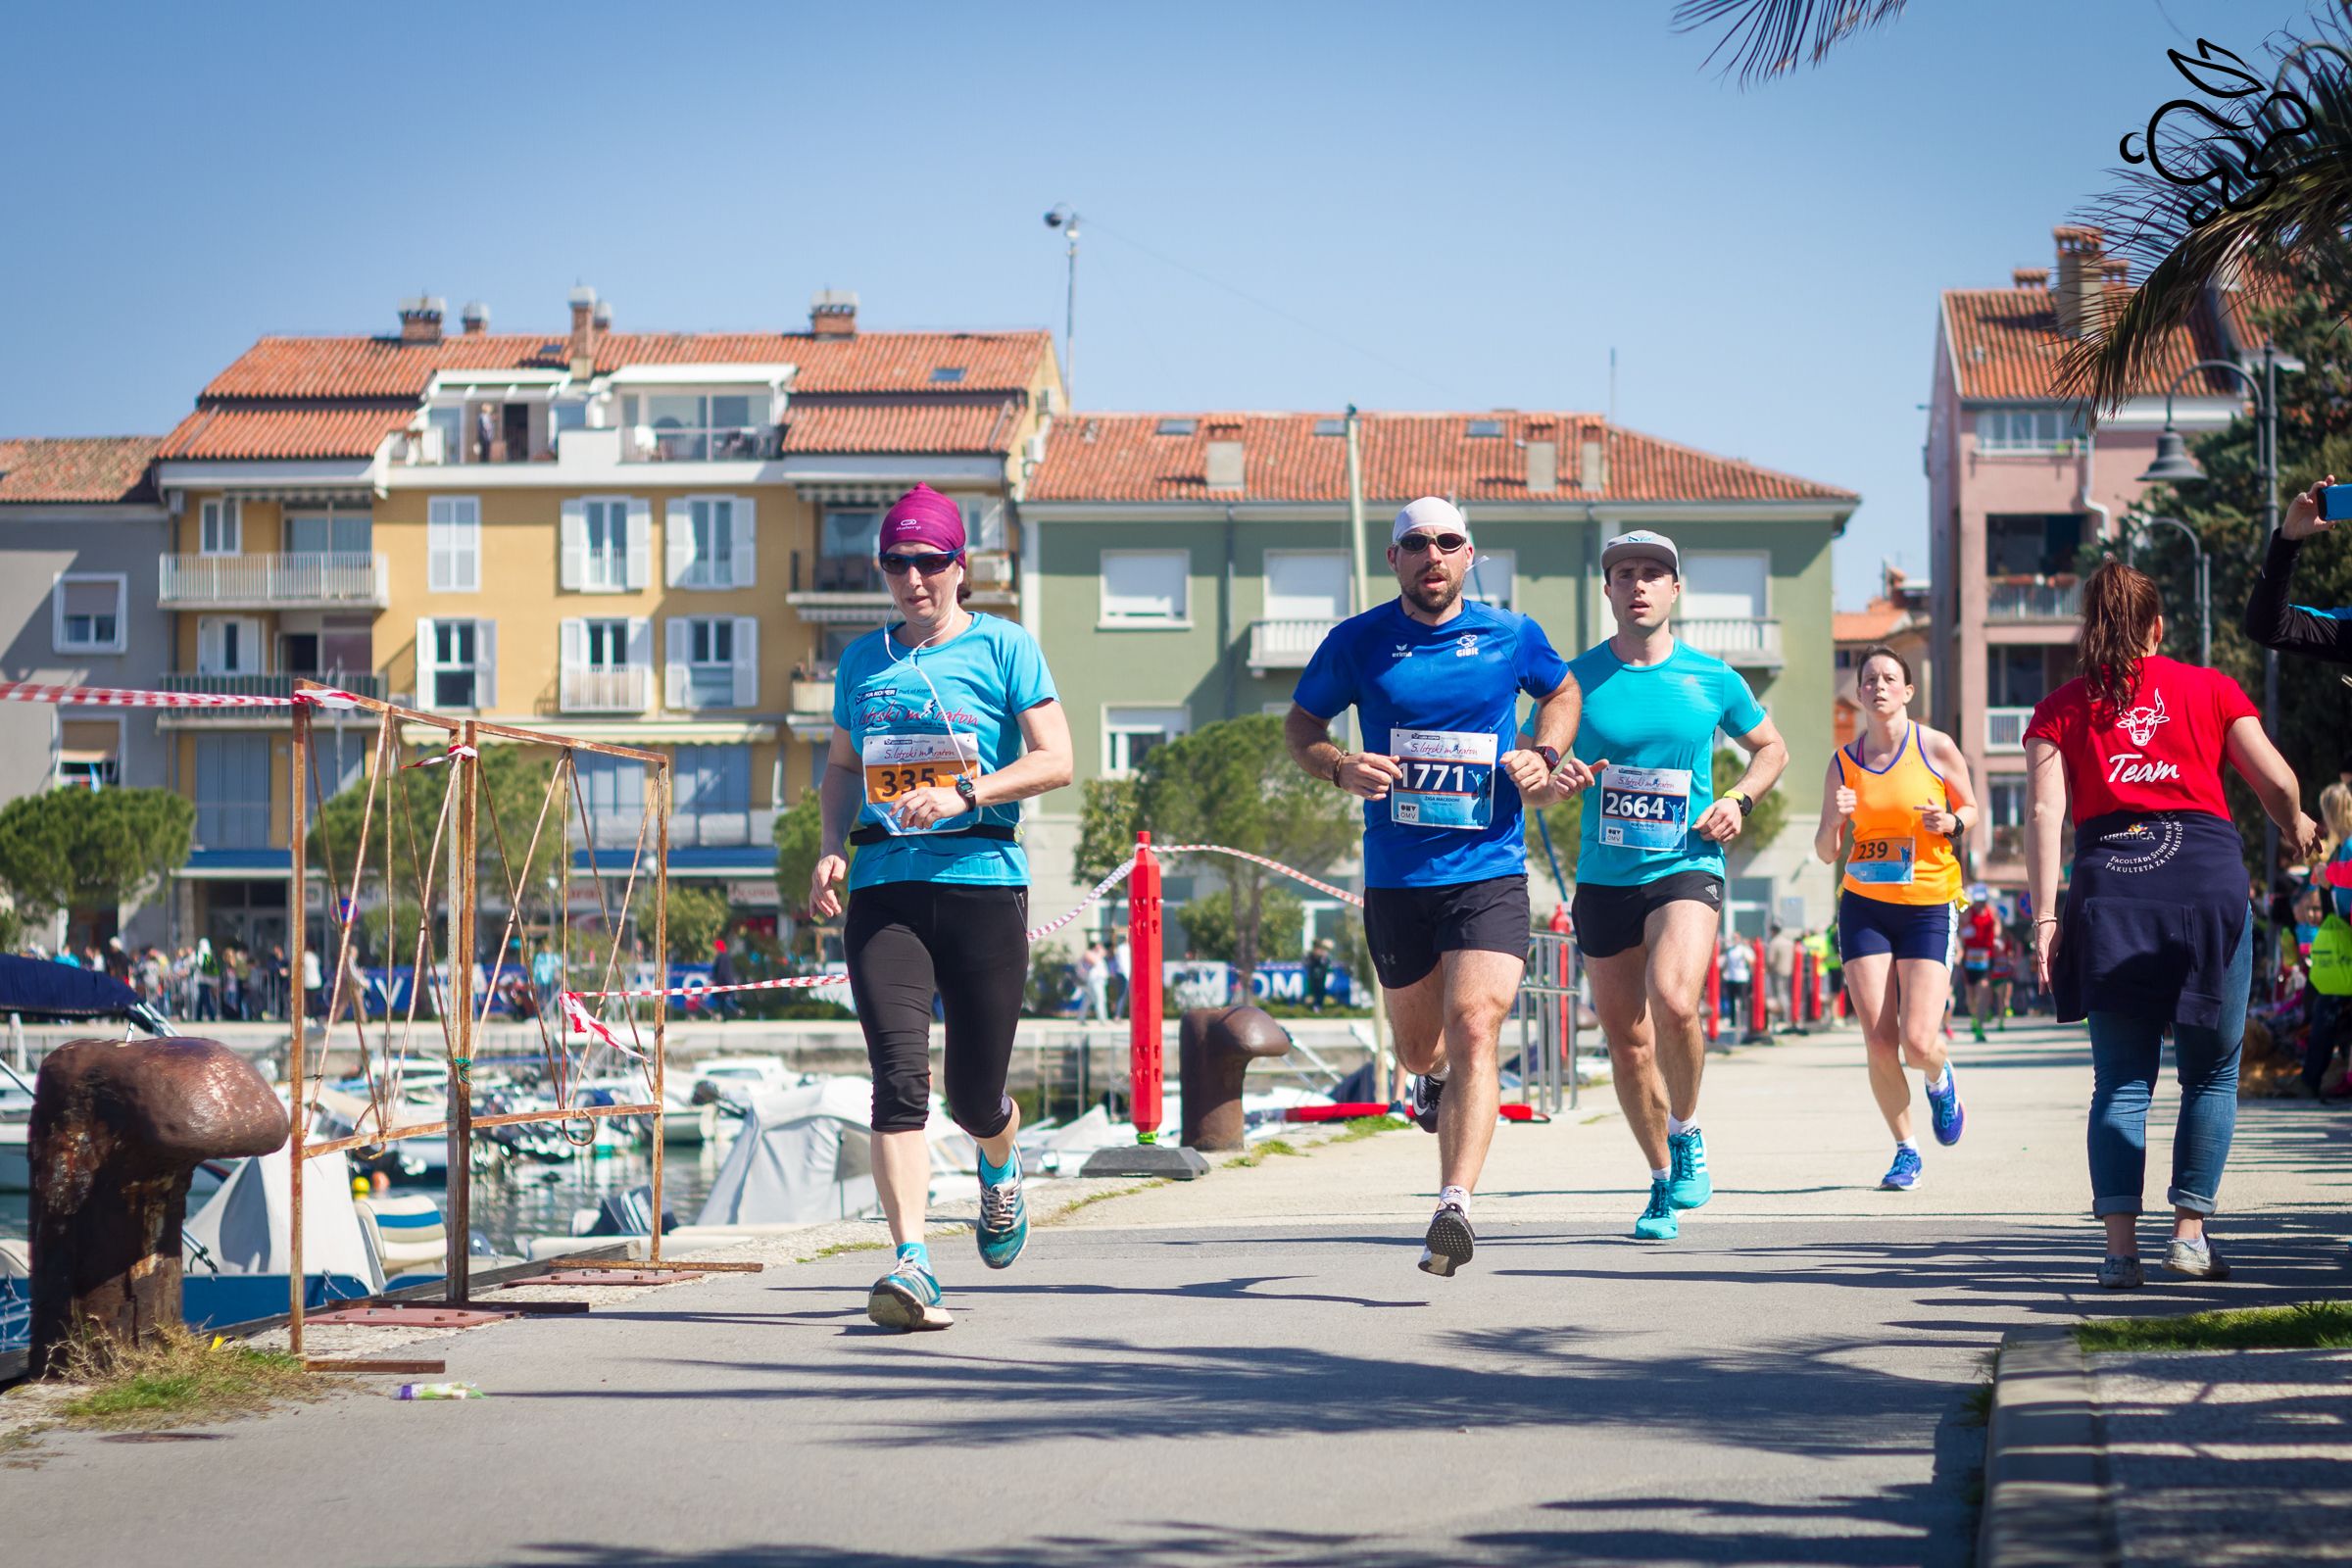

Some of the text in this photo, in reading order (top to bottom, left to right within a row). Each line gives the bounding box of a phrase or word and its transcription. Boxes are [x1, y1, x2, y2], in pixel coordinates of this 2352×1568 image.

[905, 701, 978, 726] mraton
[918, 747, 955, 759] mraton
[1444, 744, 1478, 755] mraton
[1398, 762, 1464, 792] 1771
[2108, 754, 2180, 783] Team
[881, 767, 936, 797] 335
[1605, 792, 1665, 819] 2664
[1857, 841, 1888, 859] 239
[2105, 861, 2154, 873] FAKULTETA
[2155, 858, 2166, 867] ZA
